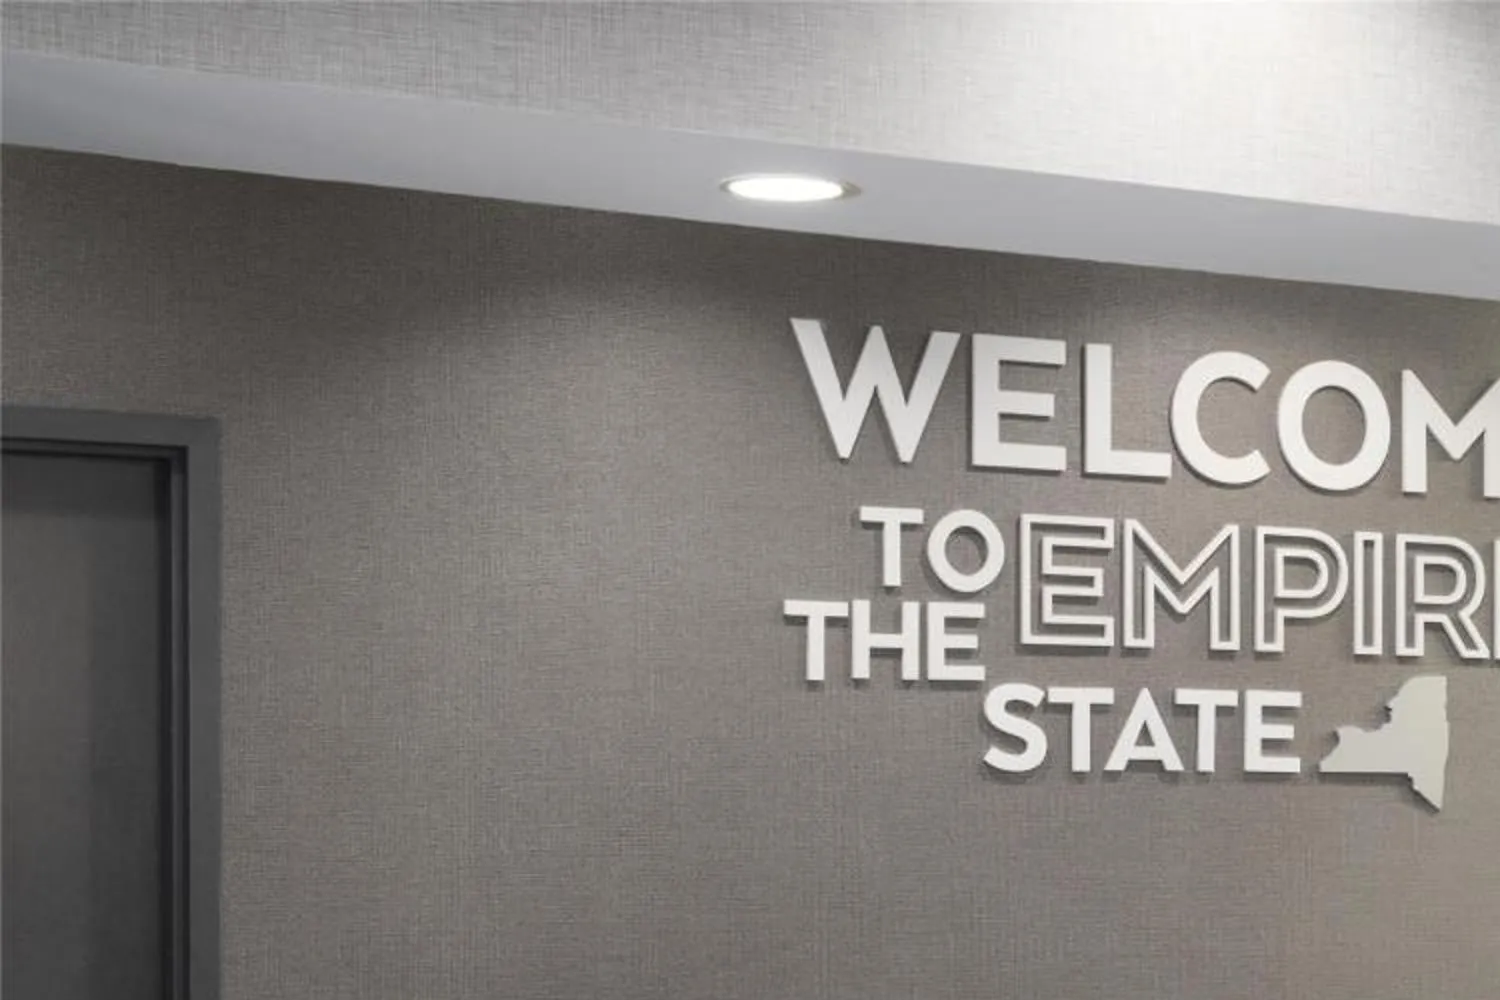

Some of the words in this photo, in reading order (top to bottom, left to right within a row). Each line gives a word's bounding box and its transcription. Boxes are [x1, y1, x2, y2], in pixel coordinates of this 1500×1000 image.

[858, 505, 1006, 594] TO
[783, 597, 987, 684] THE
[981, 682, 1304, 775] STATE
